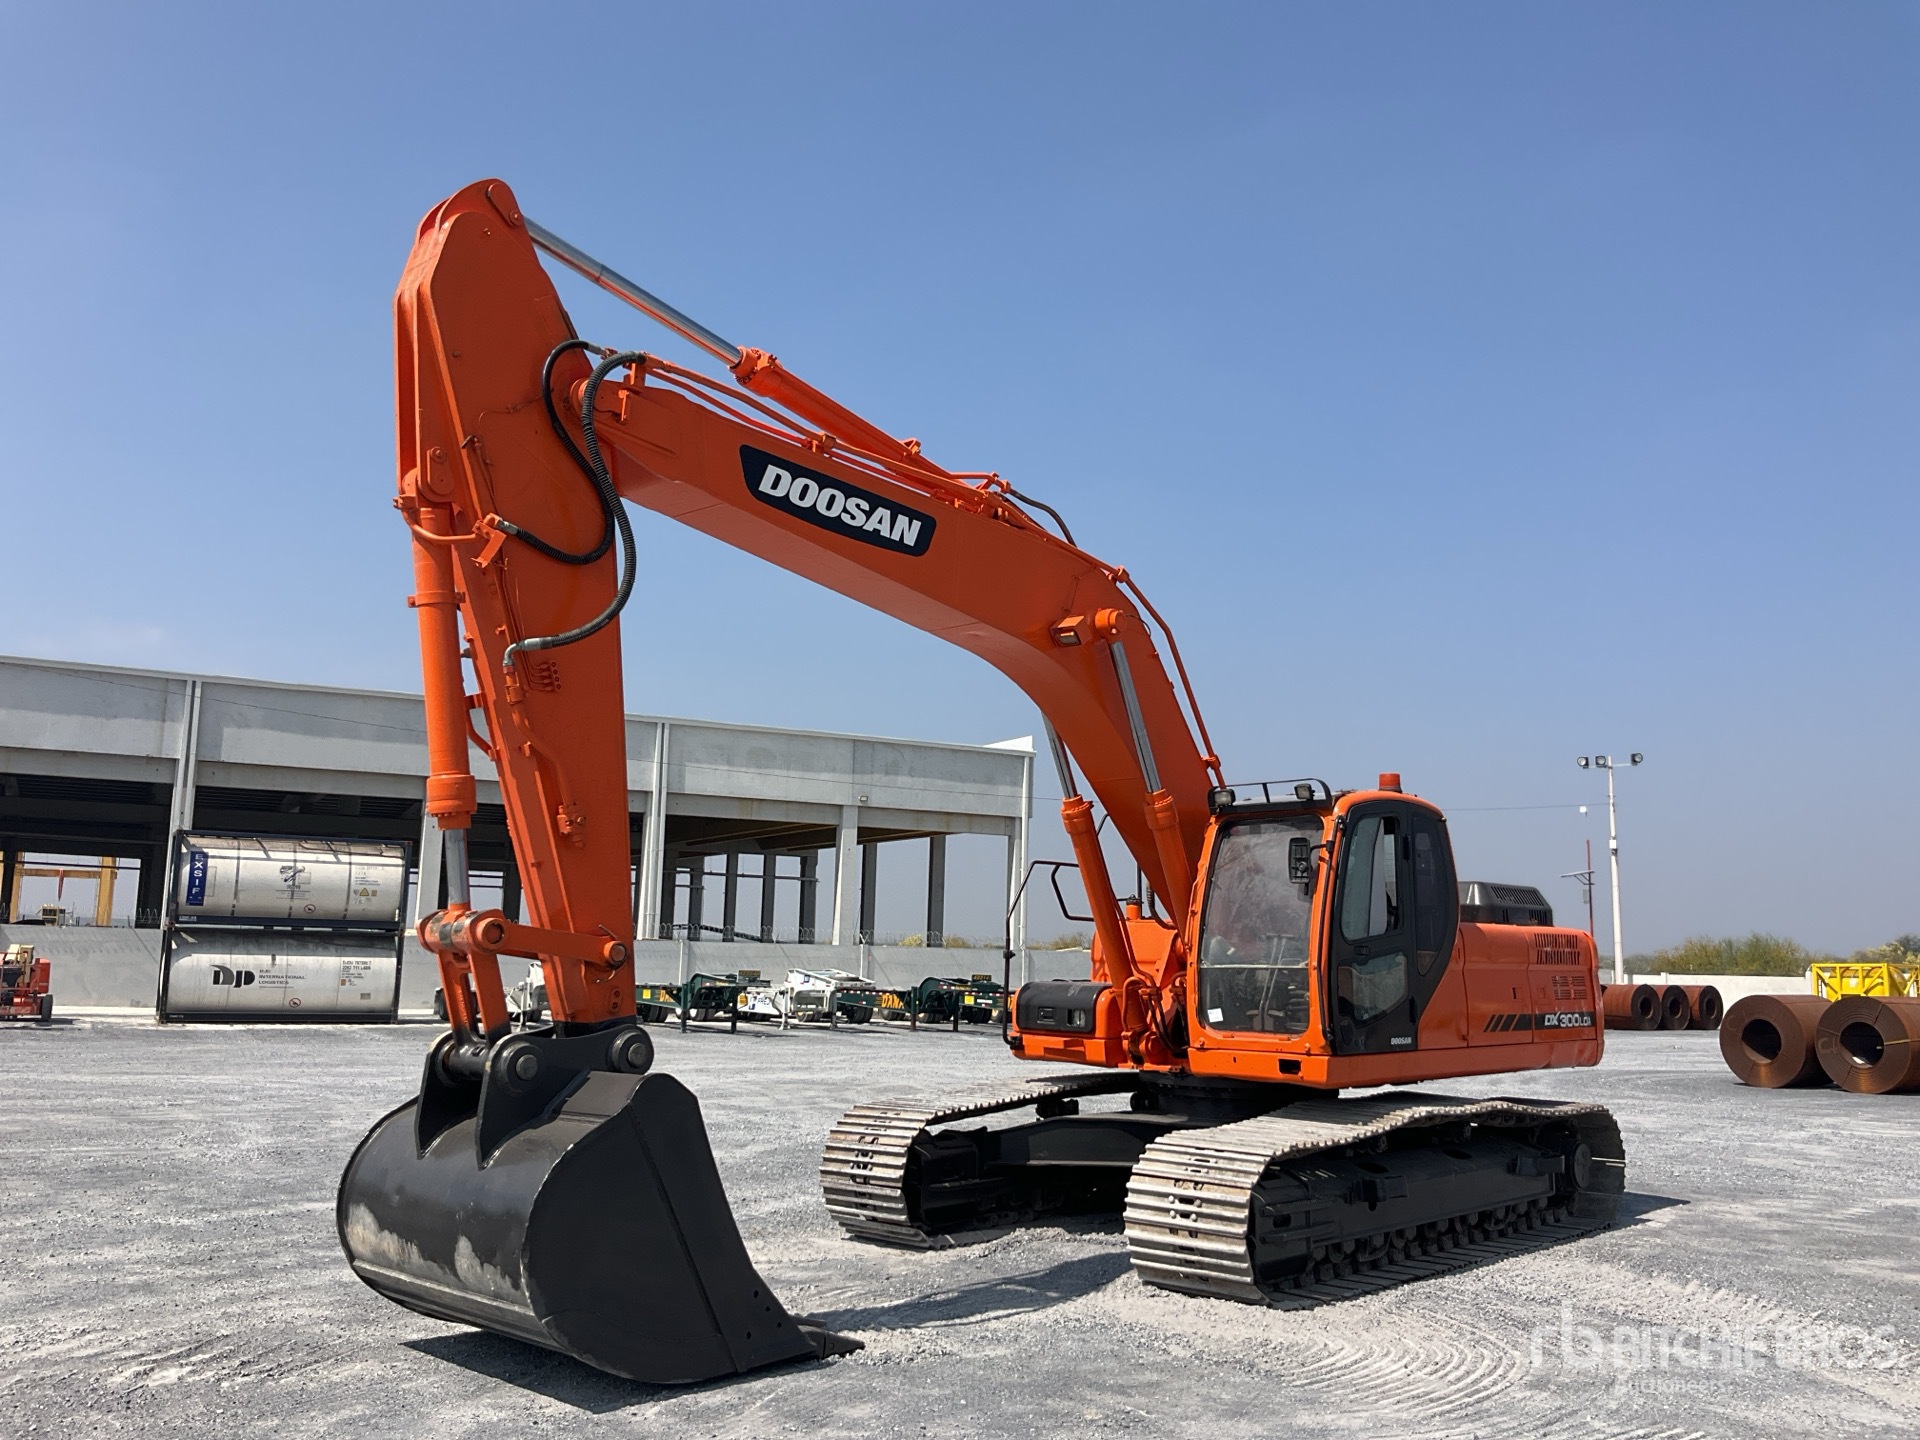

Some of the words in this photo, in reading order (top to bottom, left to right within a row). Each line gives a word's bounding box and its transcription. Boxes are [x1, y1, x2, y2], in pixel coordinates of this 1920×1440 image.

[758, 464, 922, 547] DOOSAN
[192, 853, 204, 894] EXSIF
[1390, 1036, 1412, 1045] DOOSAN
